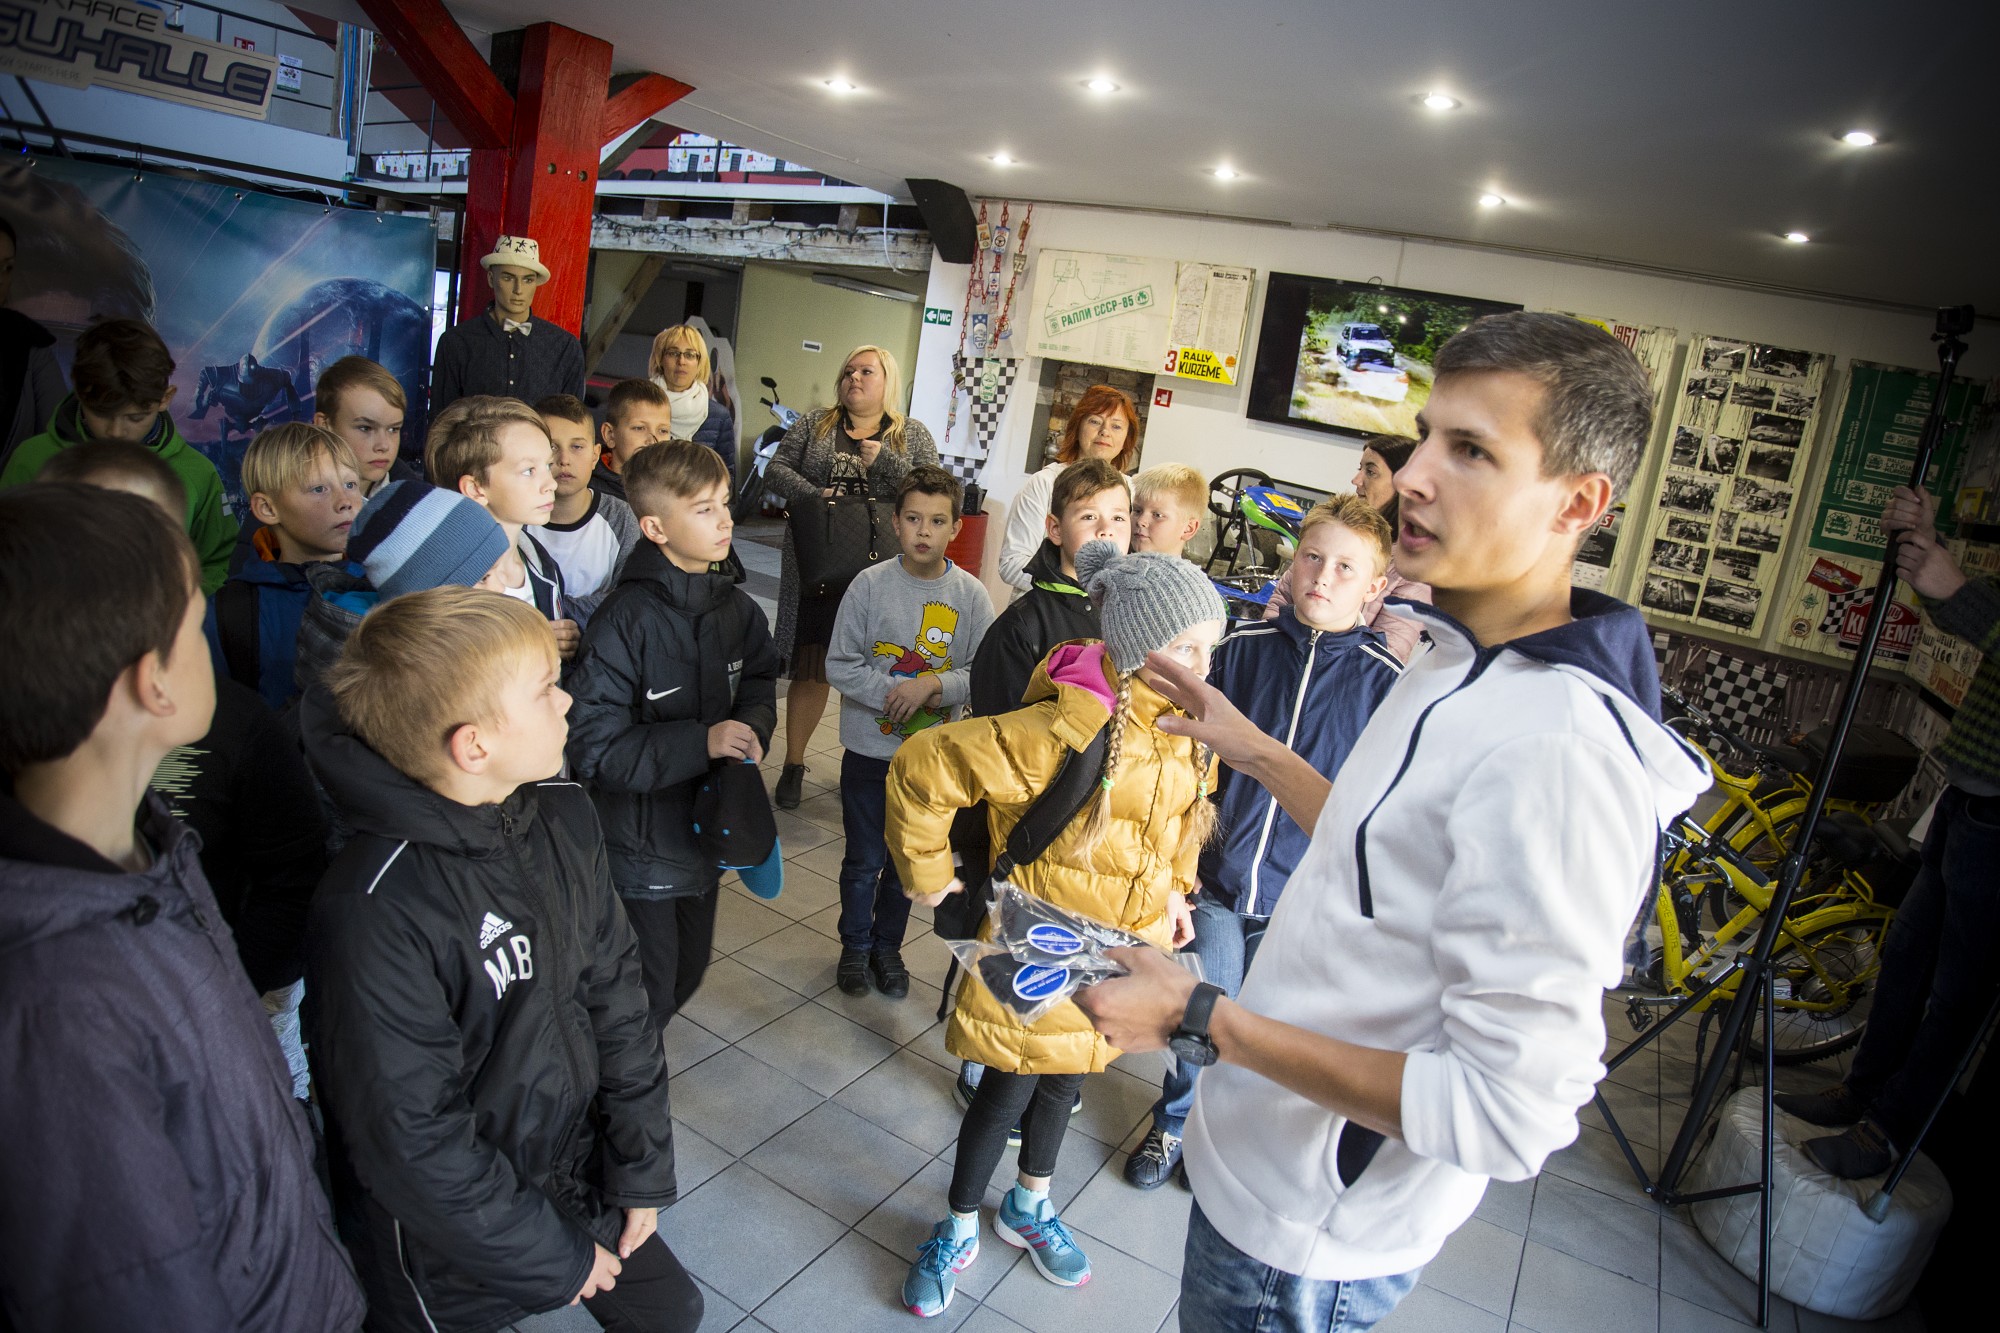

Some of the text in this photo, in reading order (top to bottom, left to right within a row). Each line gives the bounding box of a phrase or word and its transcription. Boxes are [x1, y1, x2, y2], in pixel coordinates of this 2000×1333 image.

[939, 312, 951, 323] WC
[1061, 307, 1092, 327] РАЛЛИ
[1613, 324, 1639, 351] 1967
[1164, 350, 1177, 372] 3
[1183, 351, 1212, 363] RALLY
[1178, 361, 1222, 379] KURZEME
[480, 921, 514, 950] adidas
